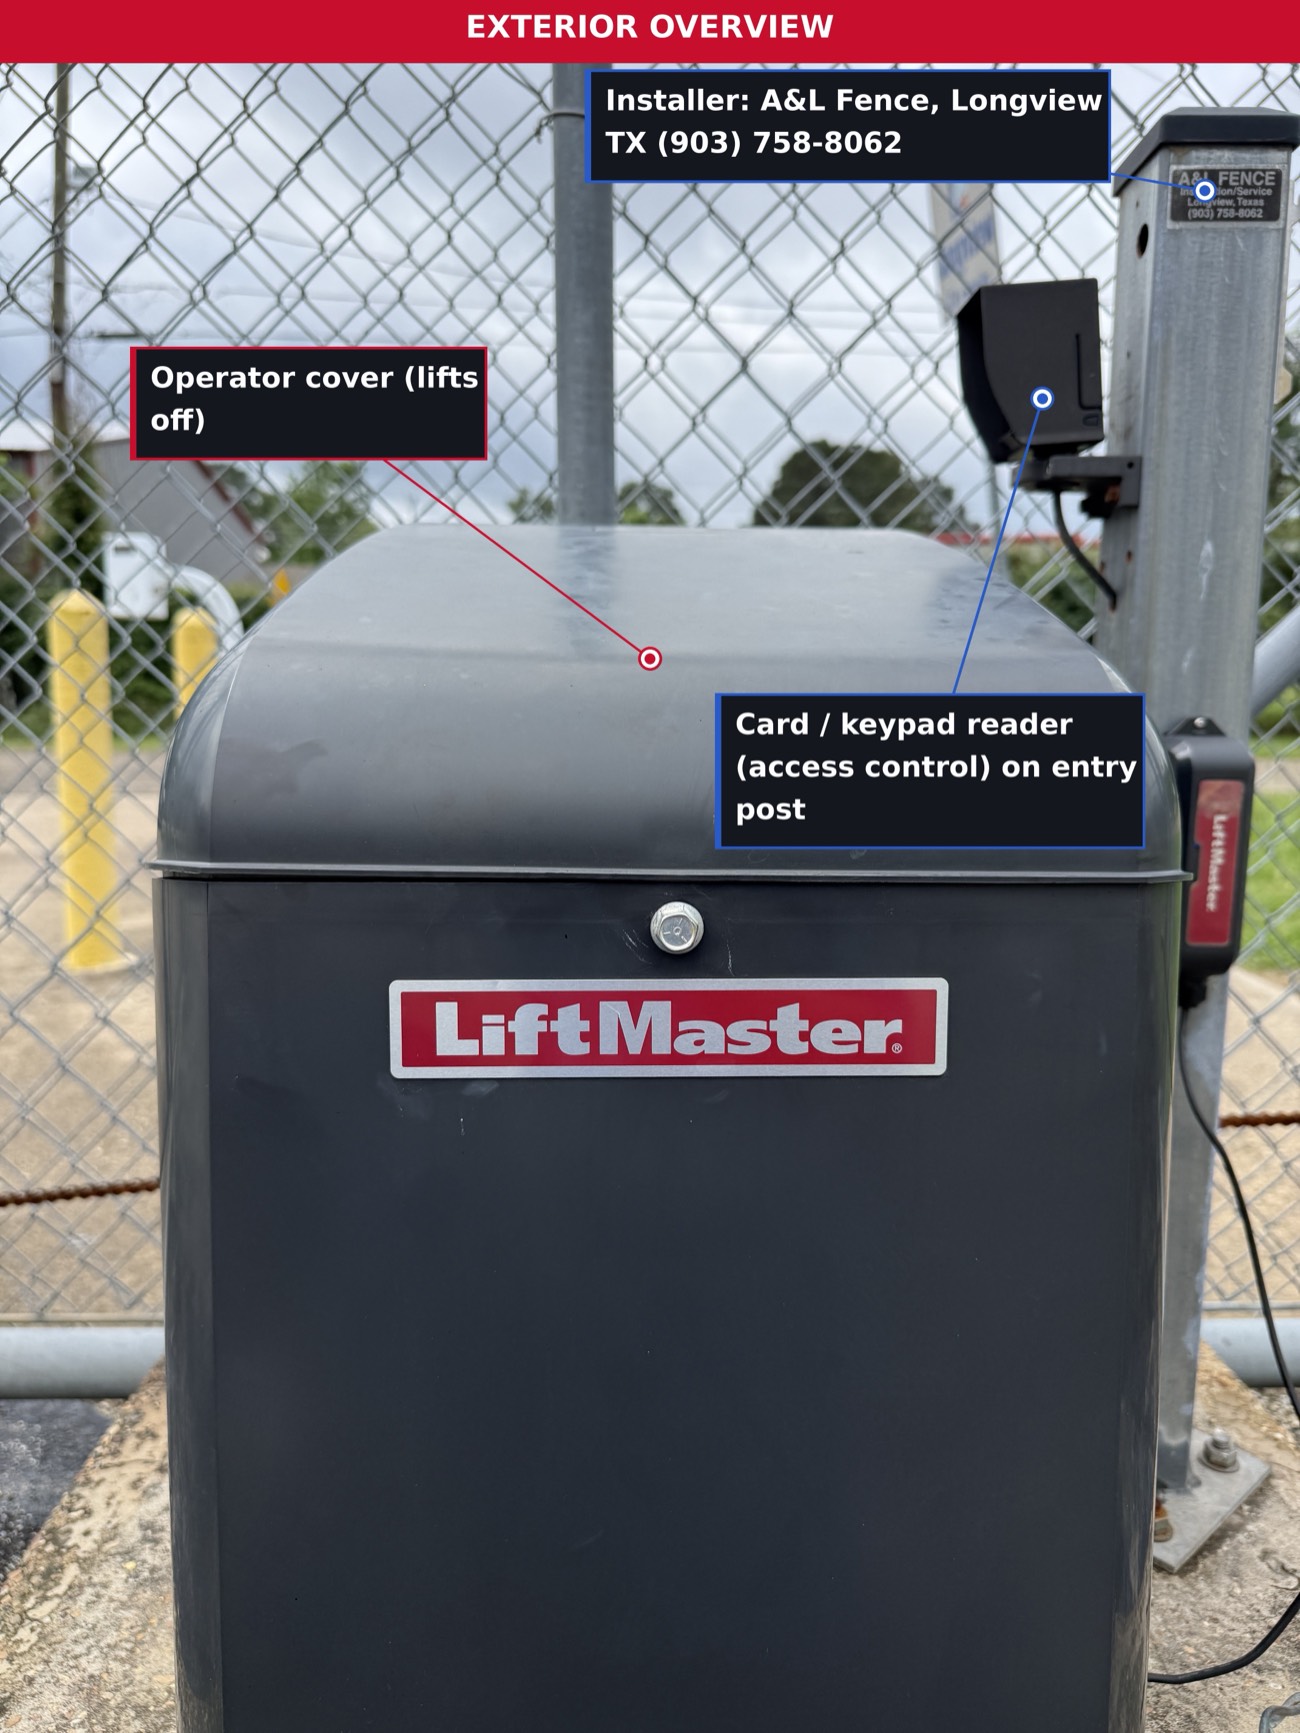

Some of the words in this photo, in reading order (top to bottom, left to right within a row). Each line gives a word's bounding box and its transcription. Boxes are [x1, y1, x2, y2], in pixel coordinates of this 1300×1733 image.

[1218, 171, 1276, 186] FENCE
[1238, 197, 1265, 207] Texas
[1187, 208, 1214, 220] (903)
[1216, 208, 1264, 219] 758-8062
